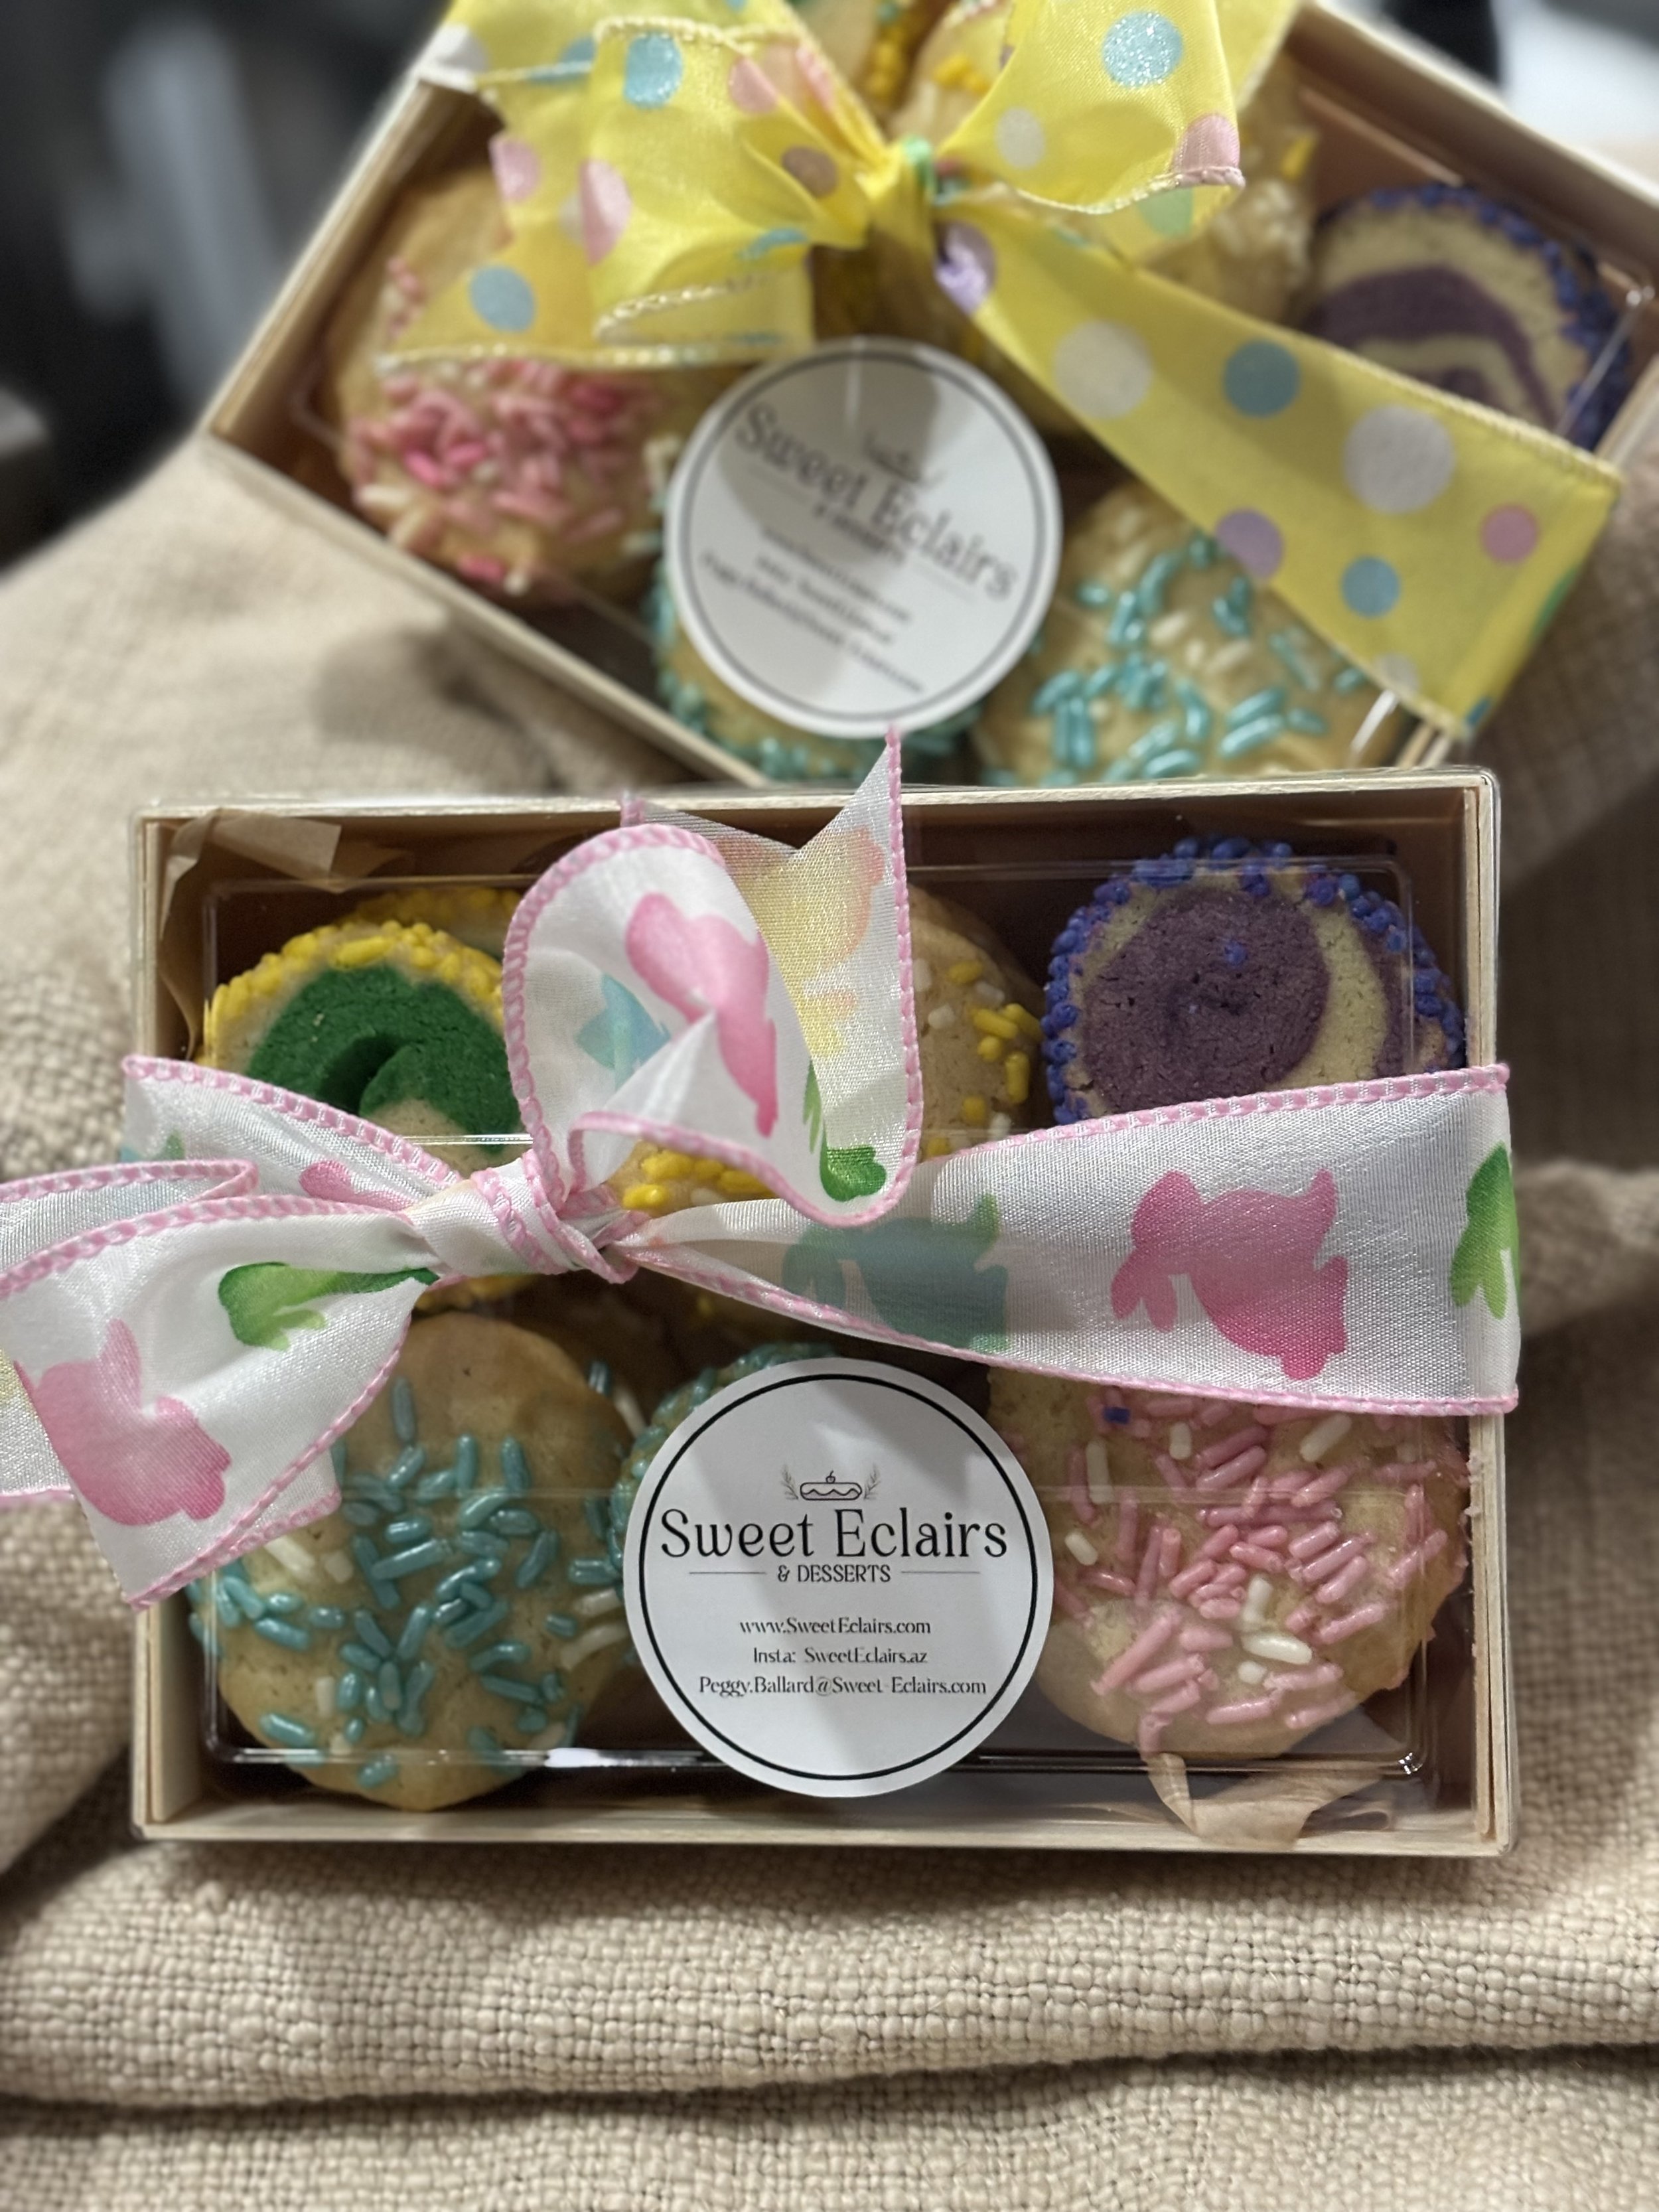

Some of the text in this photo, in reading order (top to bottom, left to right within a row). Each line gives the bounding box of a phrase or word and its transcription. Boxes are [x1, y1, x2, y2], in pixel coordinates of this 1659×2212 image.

[736, 403, 869, 508] Sweet
[871, 482, 1018, 603] Eclairs
[662, 1507, 1007, 1558] Sweet Eclairs
[777, 1564, 891, 1583] & DESSERTS
[739, 1616, 931, 1634] www.SweetEclairs.com
[753, 1647, 928, 1664] Insta: SweetEclairs.az
